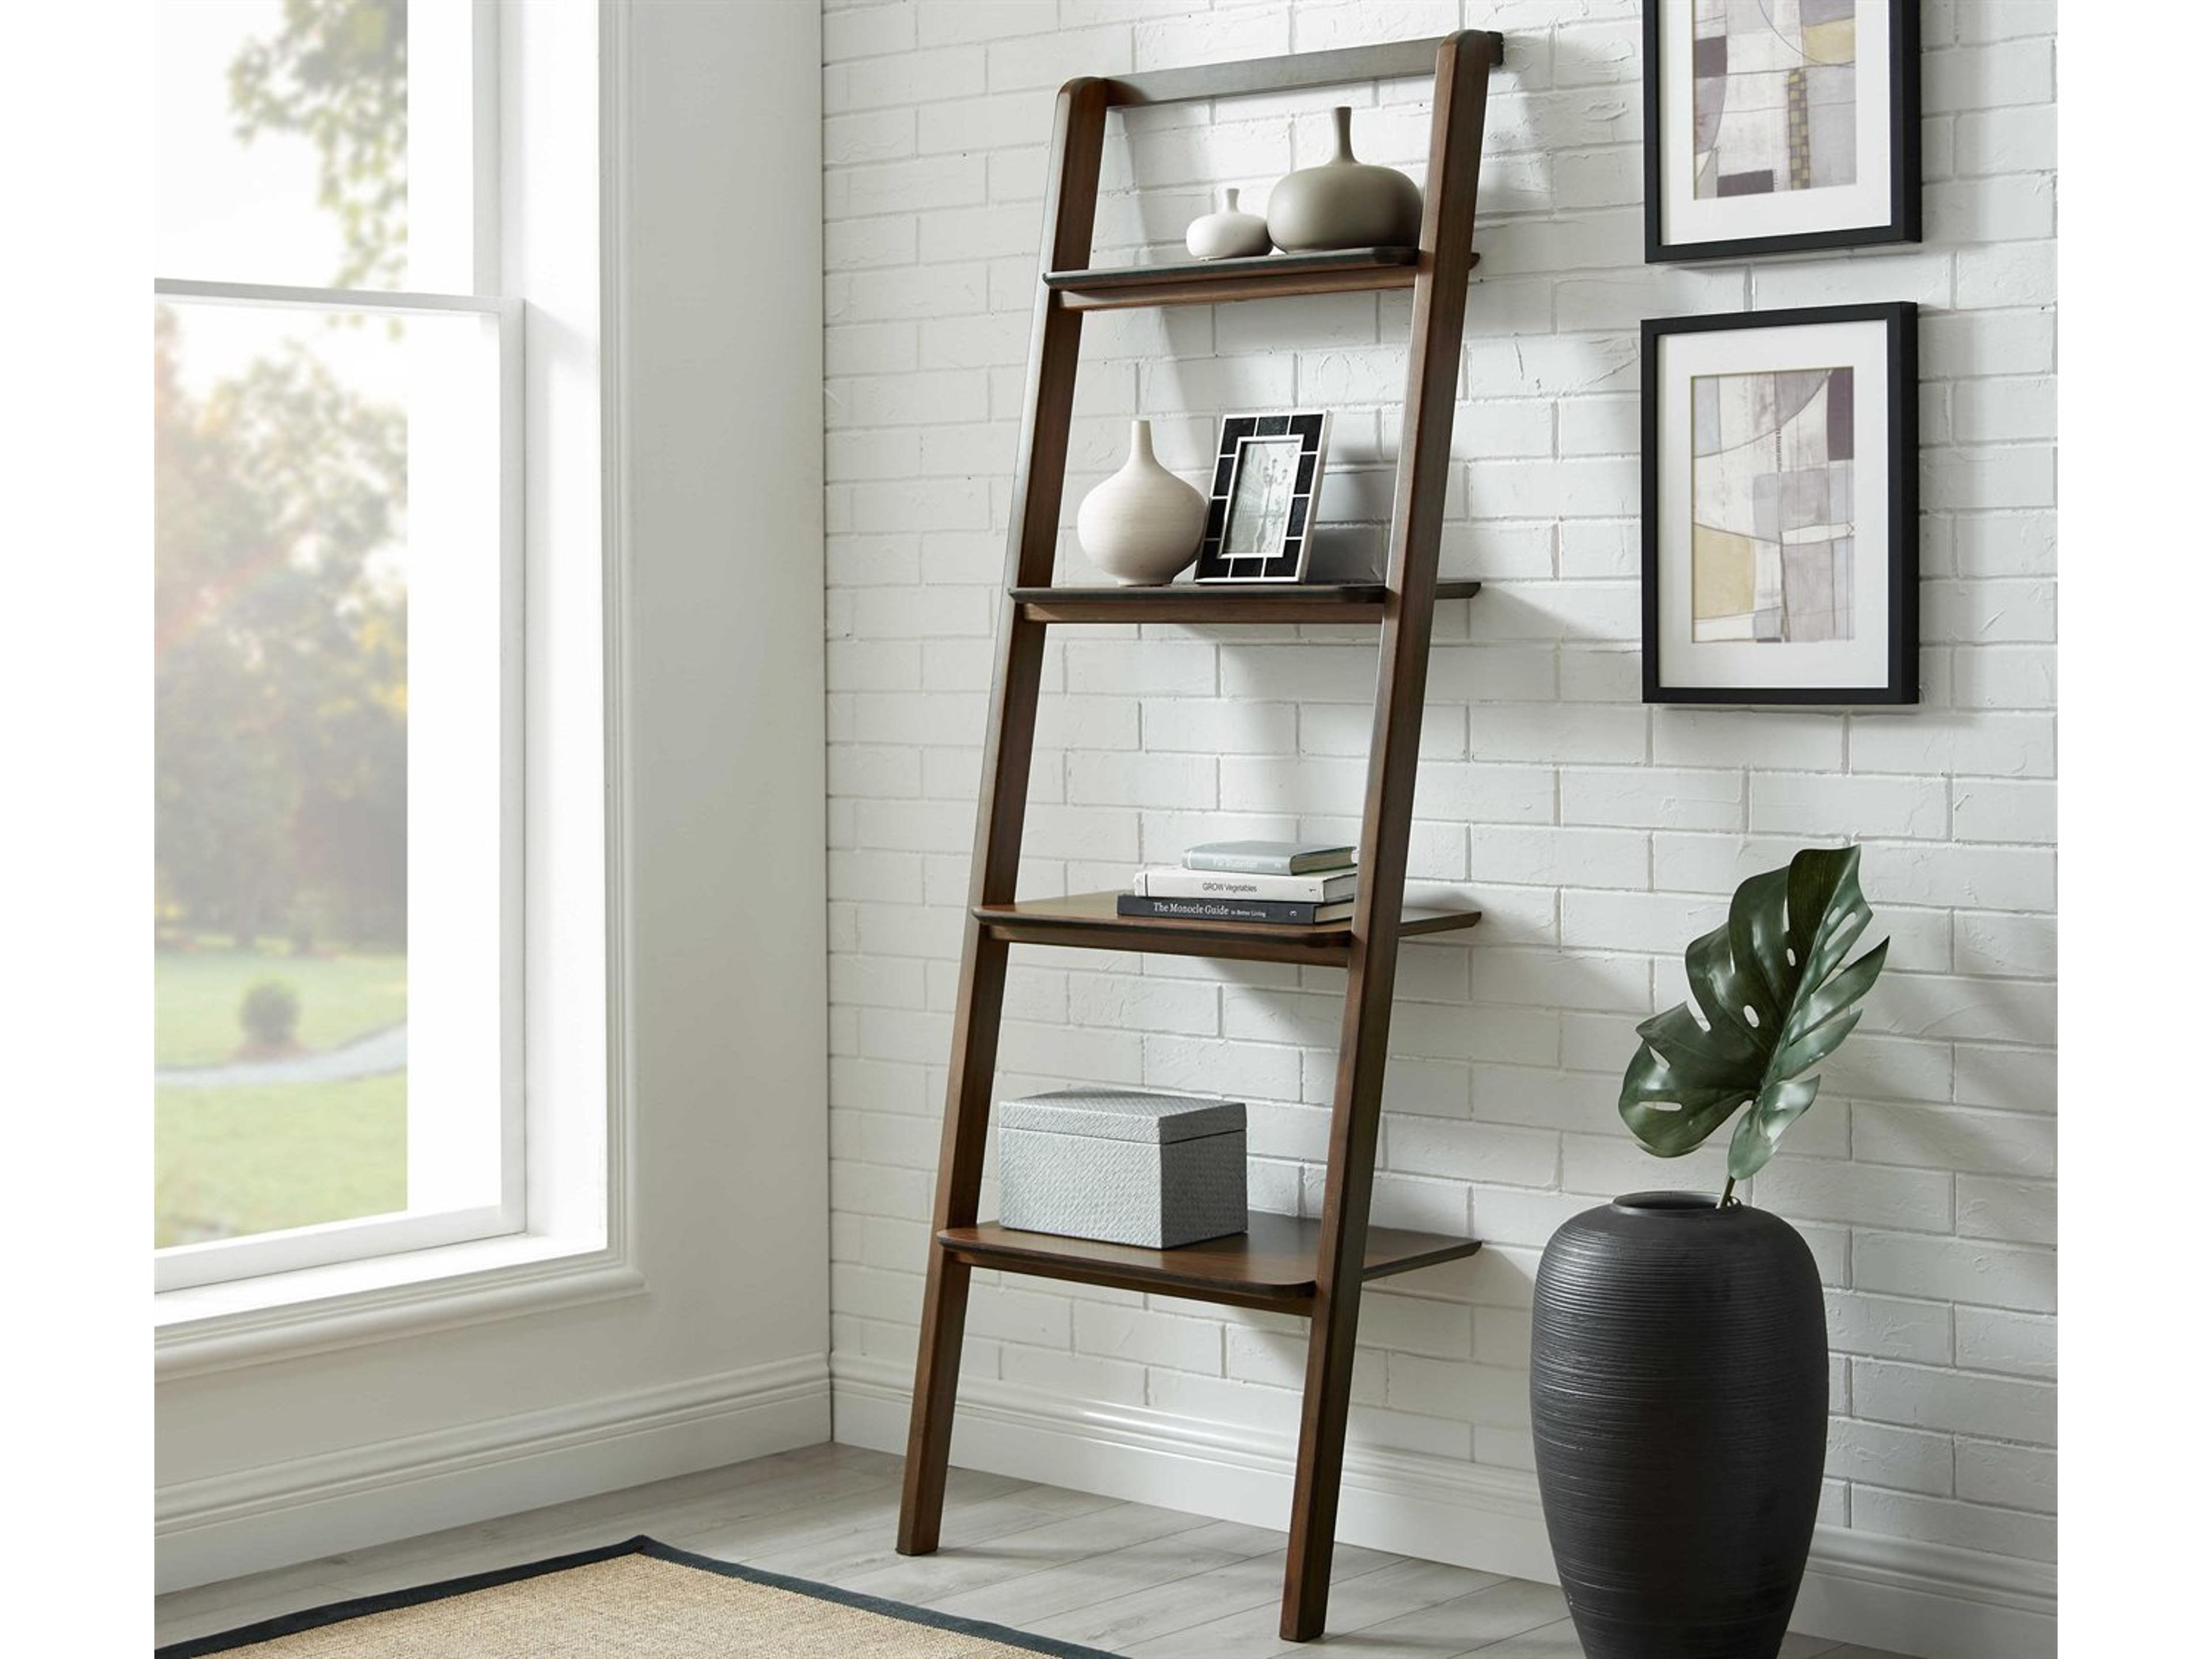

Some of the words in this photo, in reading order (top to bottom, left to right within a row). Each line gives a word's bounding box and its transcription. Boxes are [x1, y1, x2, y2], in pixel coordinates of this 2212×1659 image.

[1202, 882, 1224, 891] GROW
[1225, 884, 1257, 893] Vegetables
[1154, 902, 1169, 912] The
[1170, 903, 1203, 914] Monocle
[1205, 904, 1229, 915] Guide
[1251, 910, 1267, 918] Living
